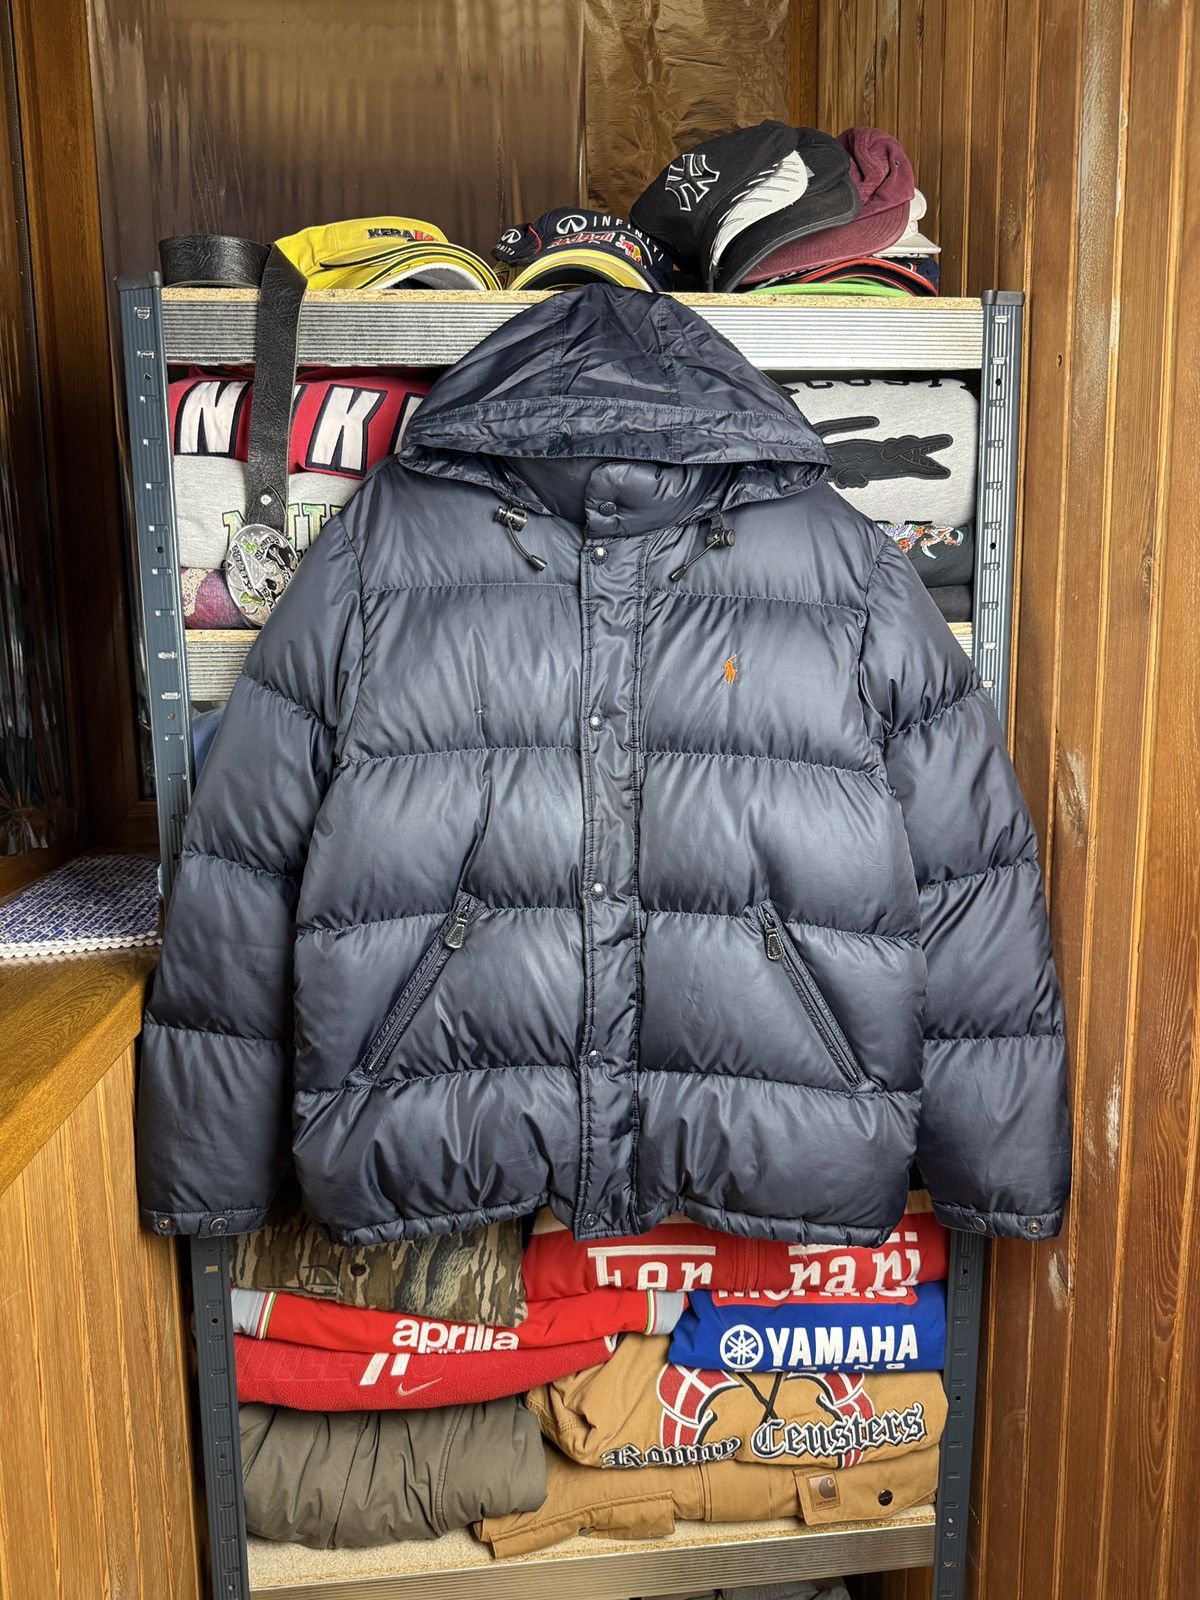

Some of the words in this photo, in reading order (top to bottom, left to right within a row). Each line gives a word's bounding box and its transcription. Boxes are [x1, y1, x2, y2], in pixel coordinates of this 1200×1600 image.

[665, 153, 720, 212] NY
[174, 380, 425, 477] NK
[392, 1318, 519, 1354] aprilia
[765, 1324, 919, 1367] YAMAHA
[750, 1401, 926, 1458] Ceusters
